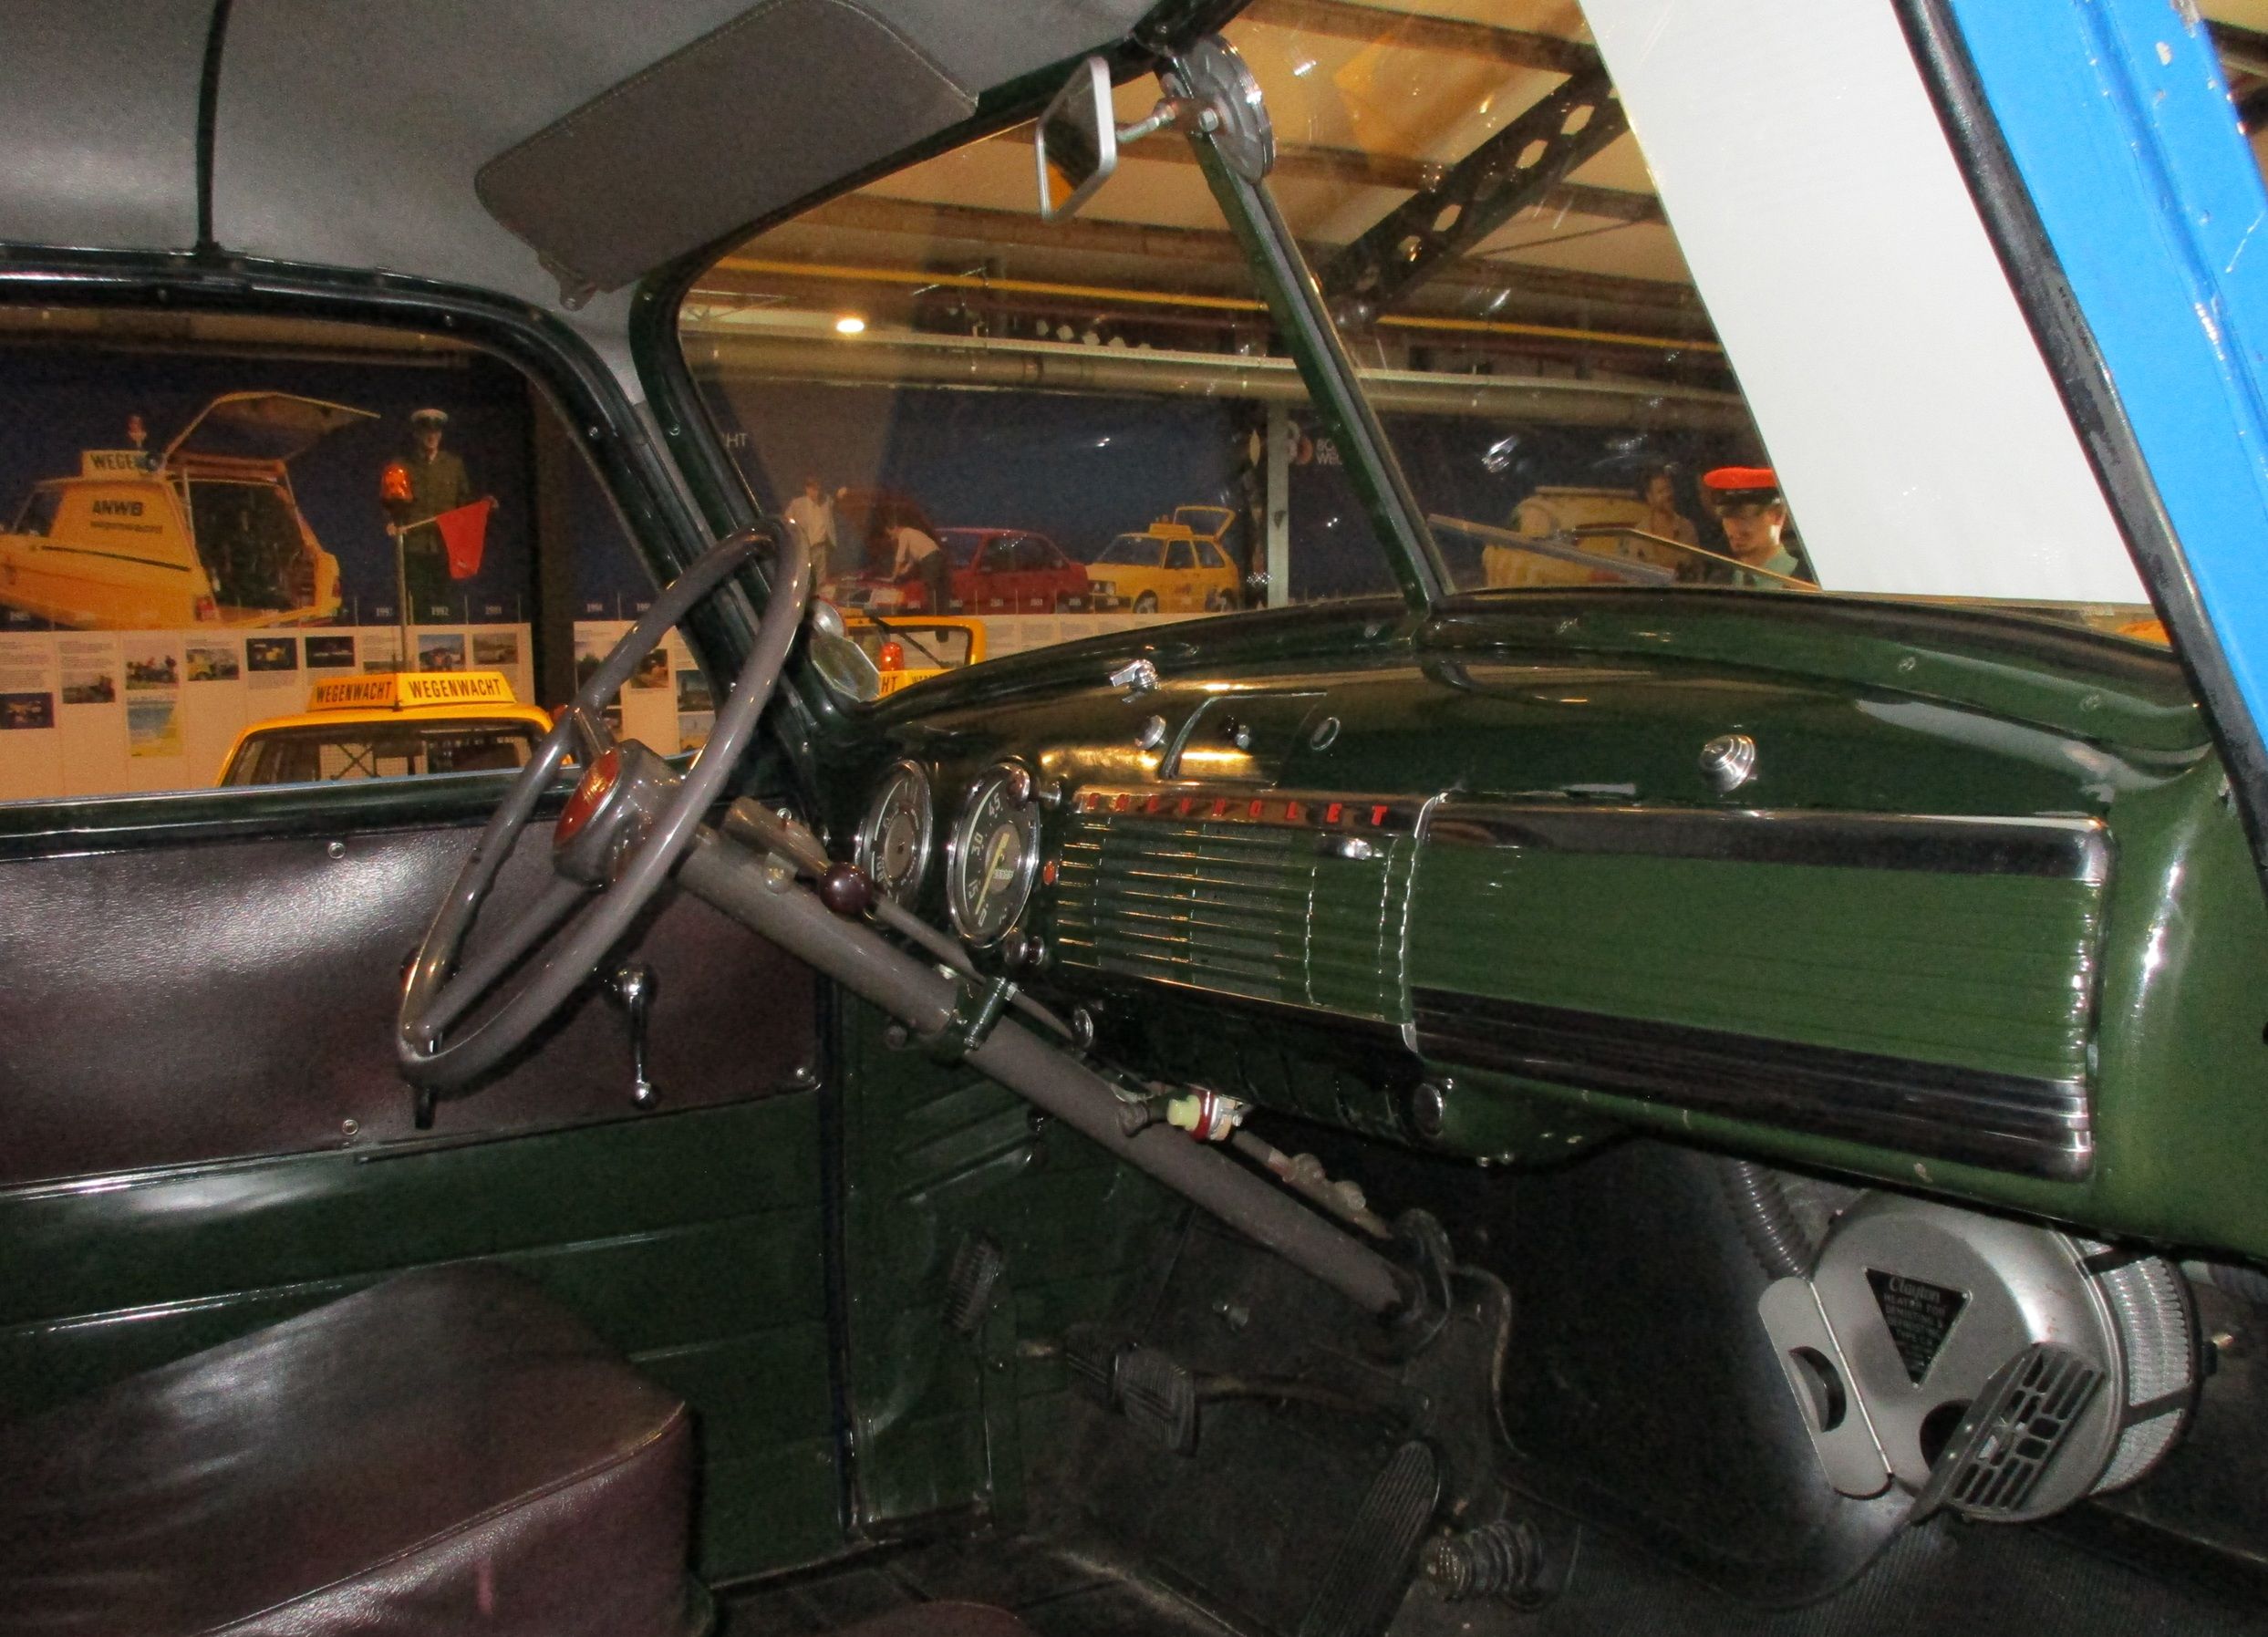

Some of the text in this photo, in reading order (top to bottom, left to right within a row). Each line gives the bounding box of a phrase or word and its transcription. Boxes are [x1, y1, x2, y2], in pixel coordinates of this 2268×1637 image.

[92, 500, 144, 517] ANWB
[316, 681, 392, 703] WEGENWACHT
[408, 678, 502, 699] WEGENWACHT
[1085, 792, 1389, 826] CHEVROLET
[971, 831, 984, 856] 30
